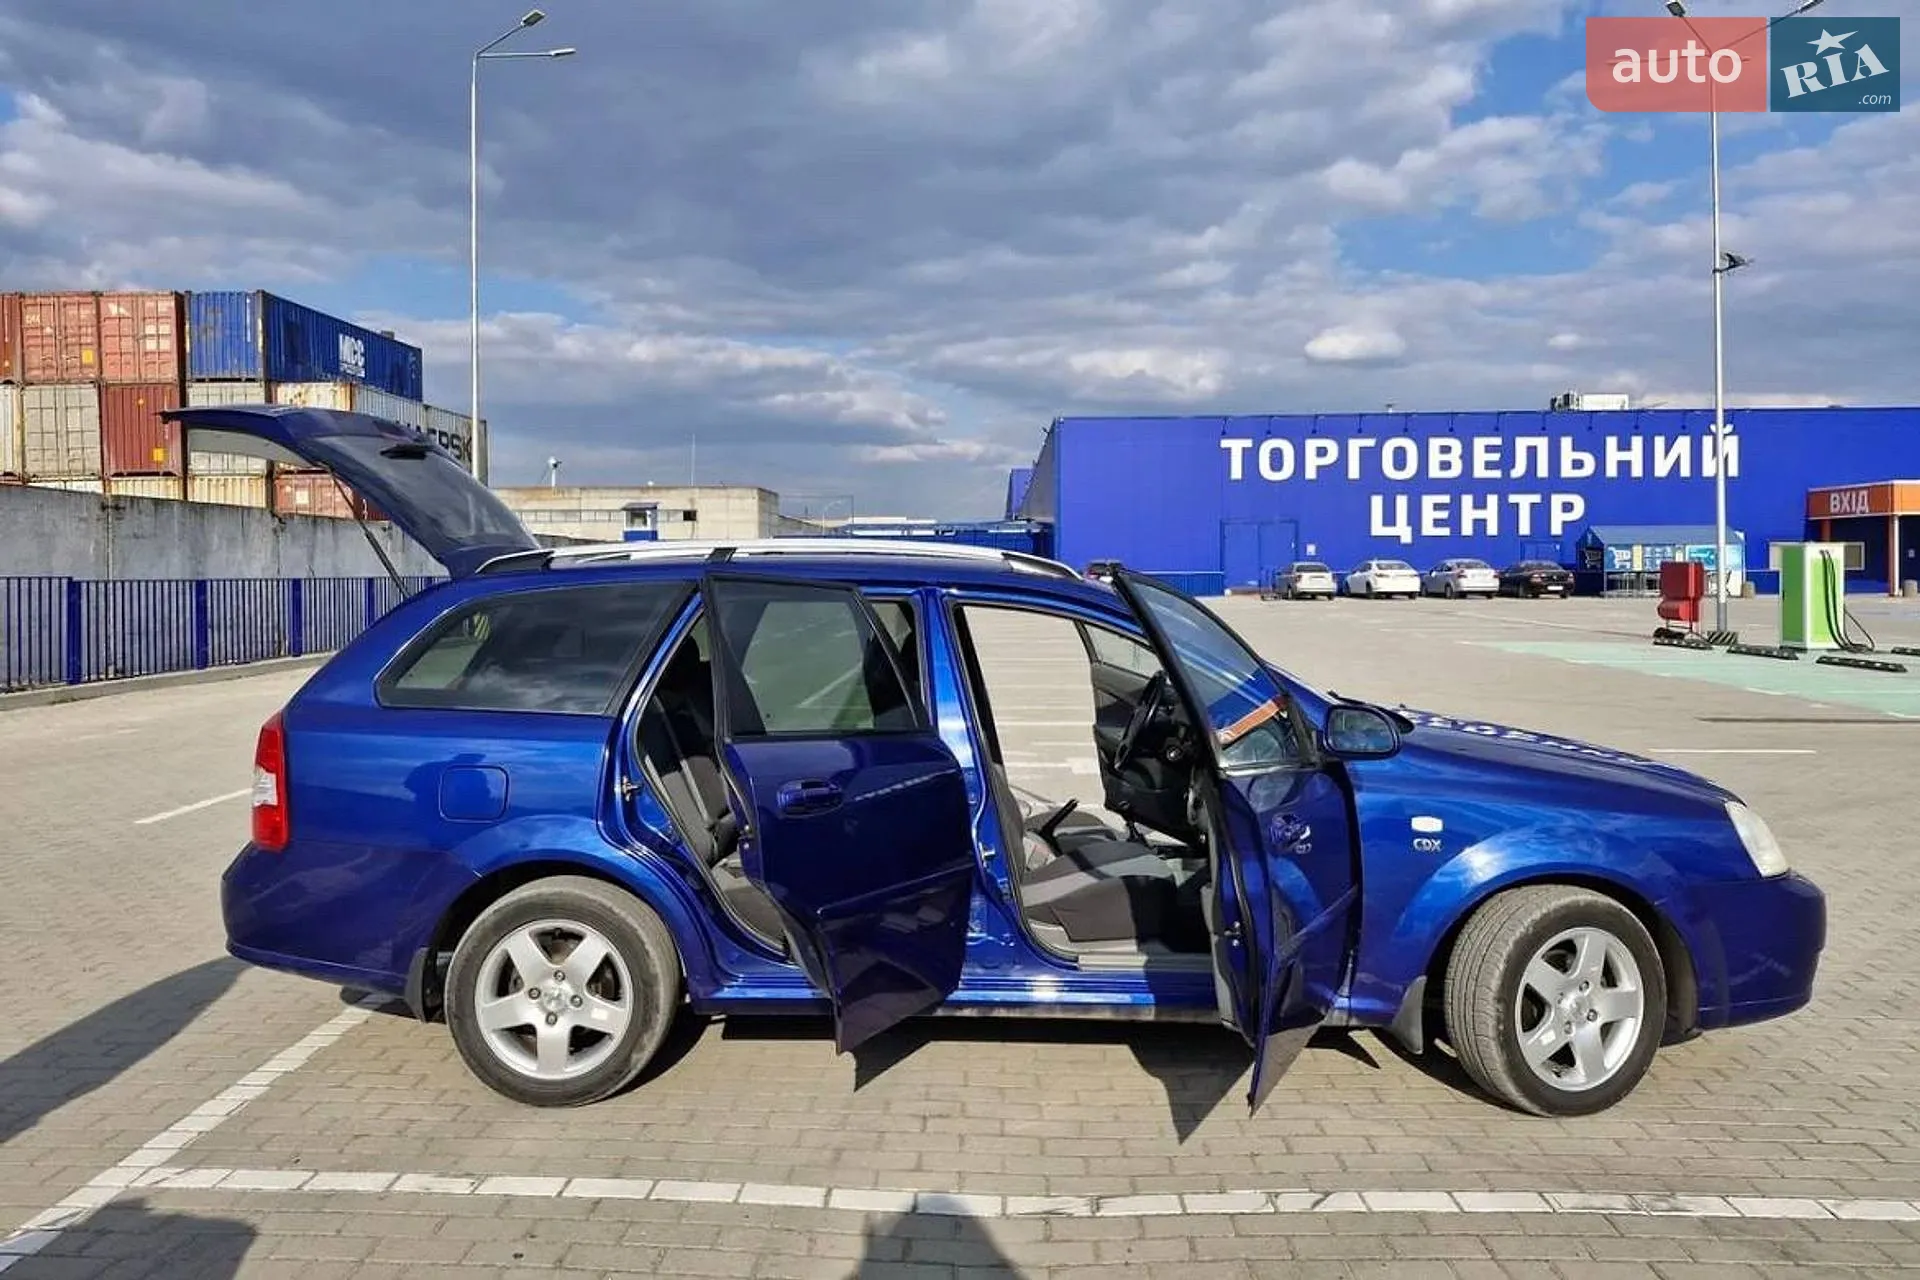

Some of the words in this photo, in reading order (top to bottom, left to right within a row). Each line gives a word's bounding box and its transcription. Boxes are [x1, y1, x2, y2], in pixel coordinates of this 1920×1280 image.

[1220, 423, 1740, 480] ТОРГОВЕЛЬНИЙ
[1369, 492, 1586, 544] ЦЕНТР
[1829, 490, 1869, 514] ВХІД
[1412, 837, 1442, 853] CDX
